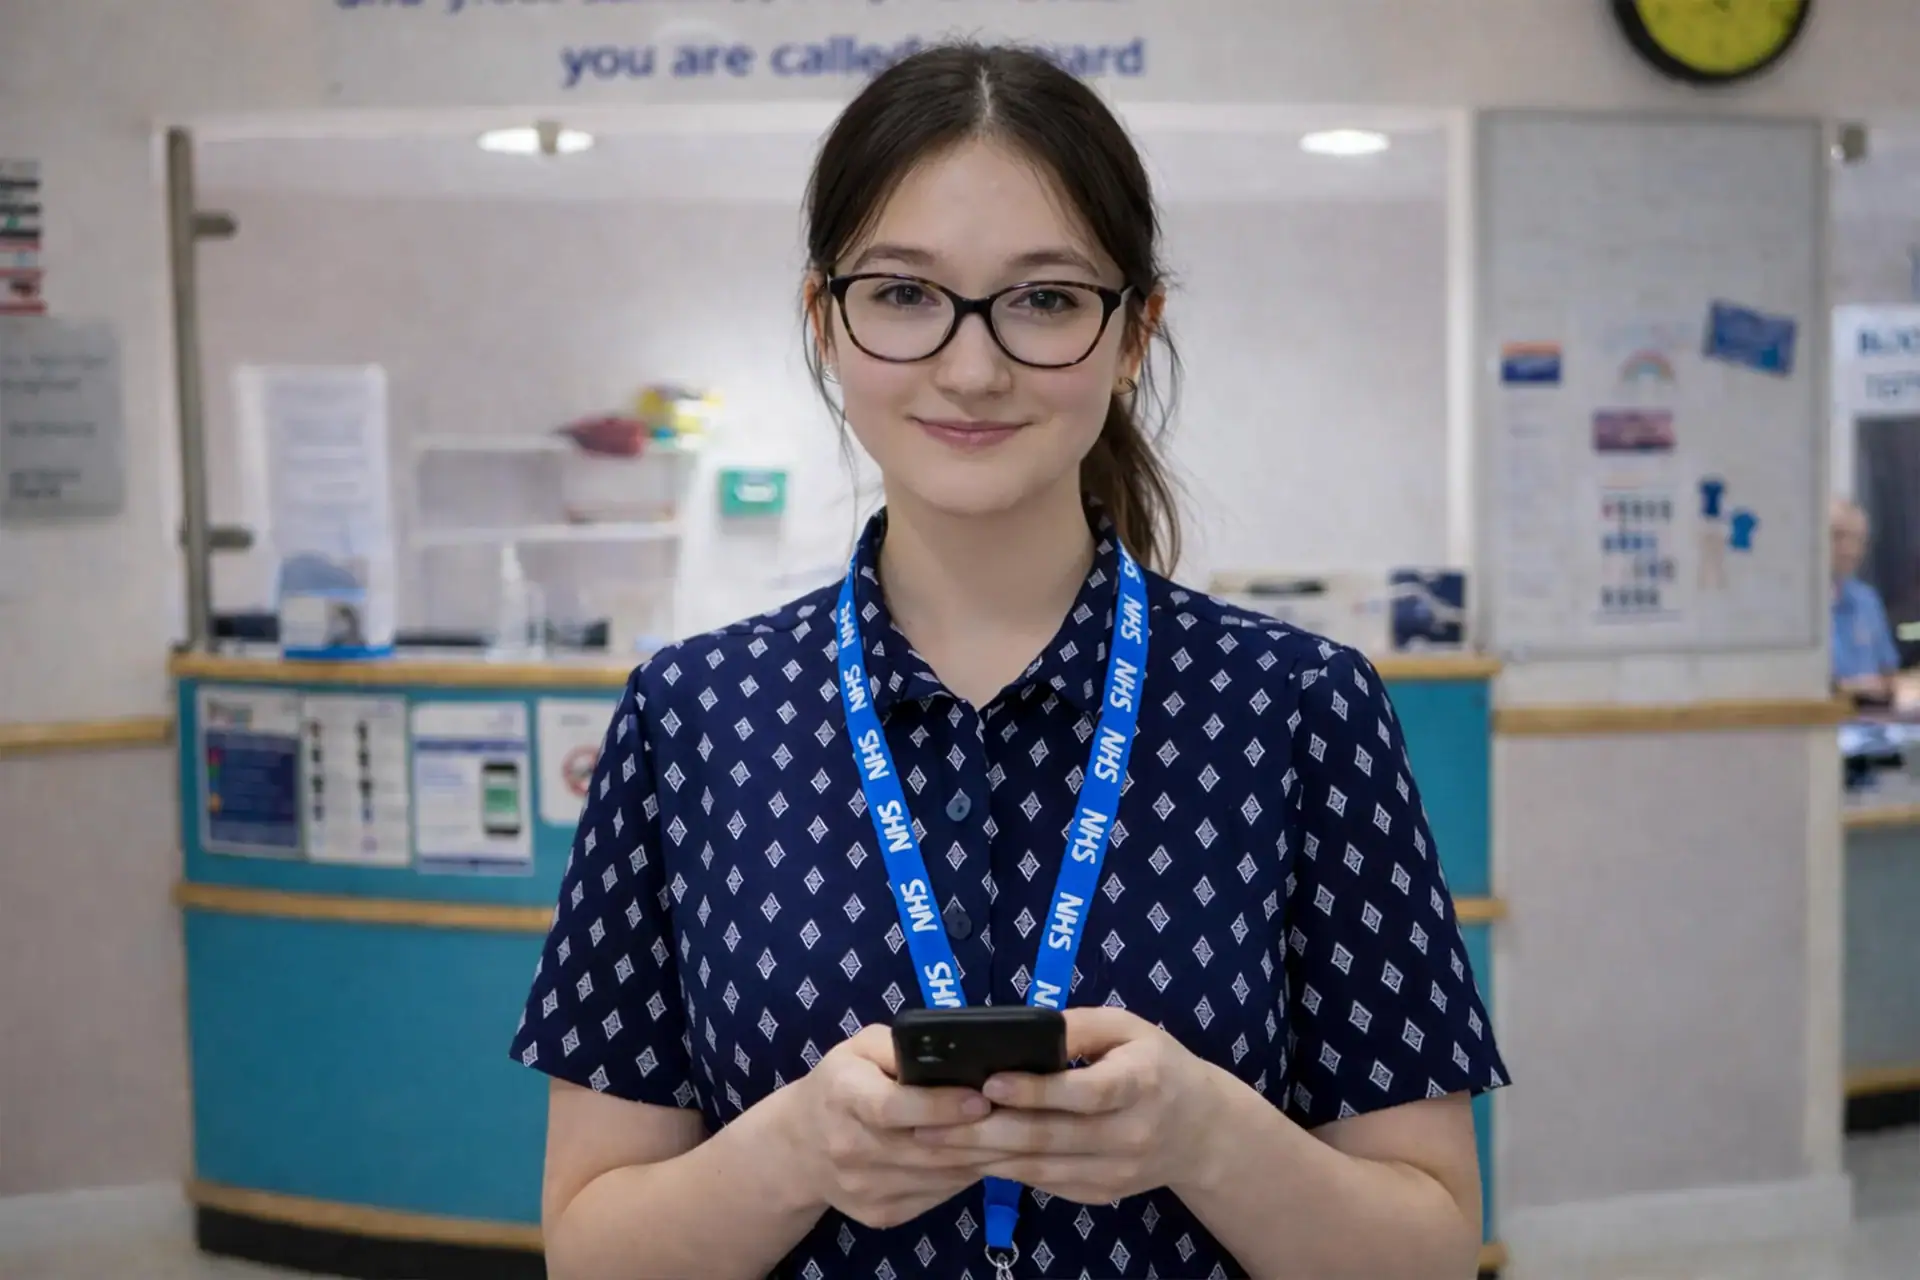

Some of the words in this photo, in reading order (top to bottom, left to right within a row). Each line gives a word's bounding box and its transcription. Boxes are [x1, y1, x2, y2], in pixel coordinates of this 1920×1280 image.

[561, 46, 655, 89] you
[673, 45, 753, 77] are
[839, 601, 857, 649] NHS
[1121, 592, 1143, 645] NHS
[843, 664, 867, 713] NHS
[1110, 658, 1138, 712] NHS
[857, 729, 890, 780] NHS
[1095, 726, 1126, 784] NHS
[877, 800, 913, 853] NHS
[1071, 807, 1108, 864] NHS
[900, 878, 938, 932] NHS
[1048, 892, 1084, 951] NHS
